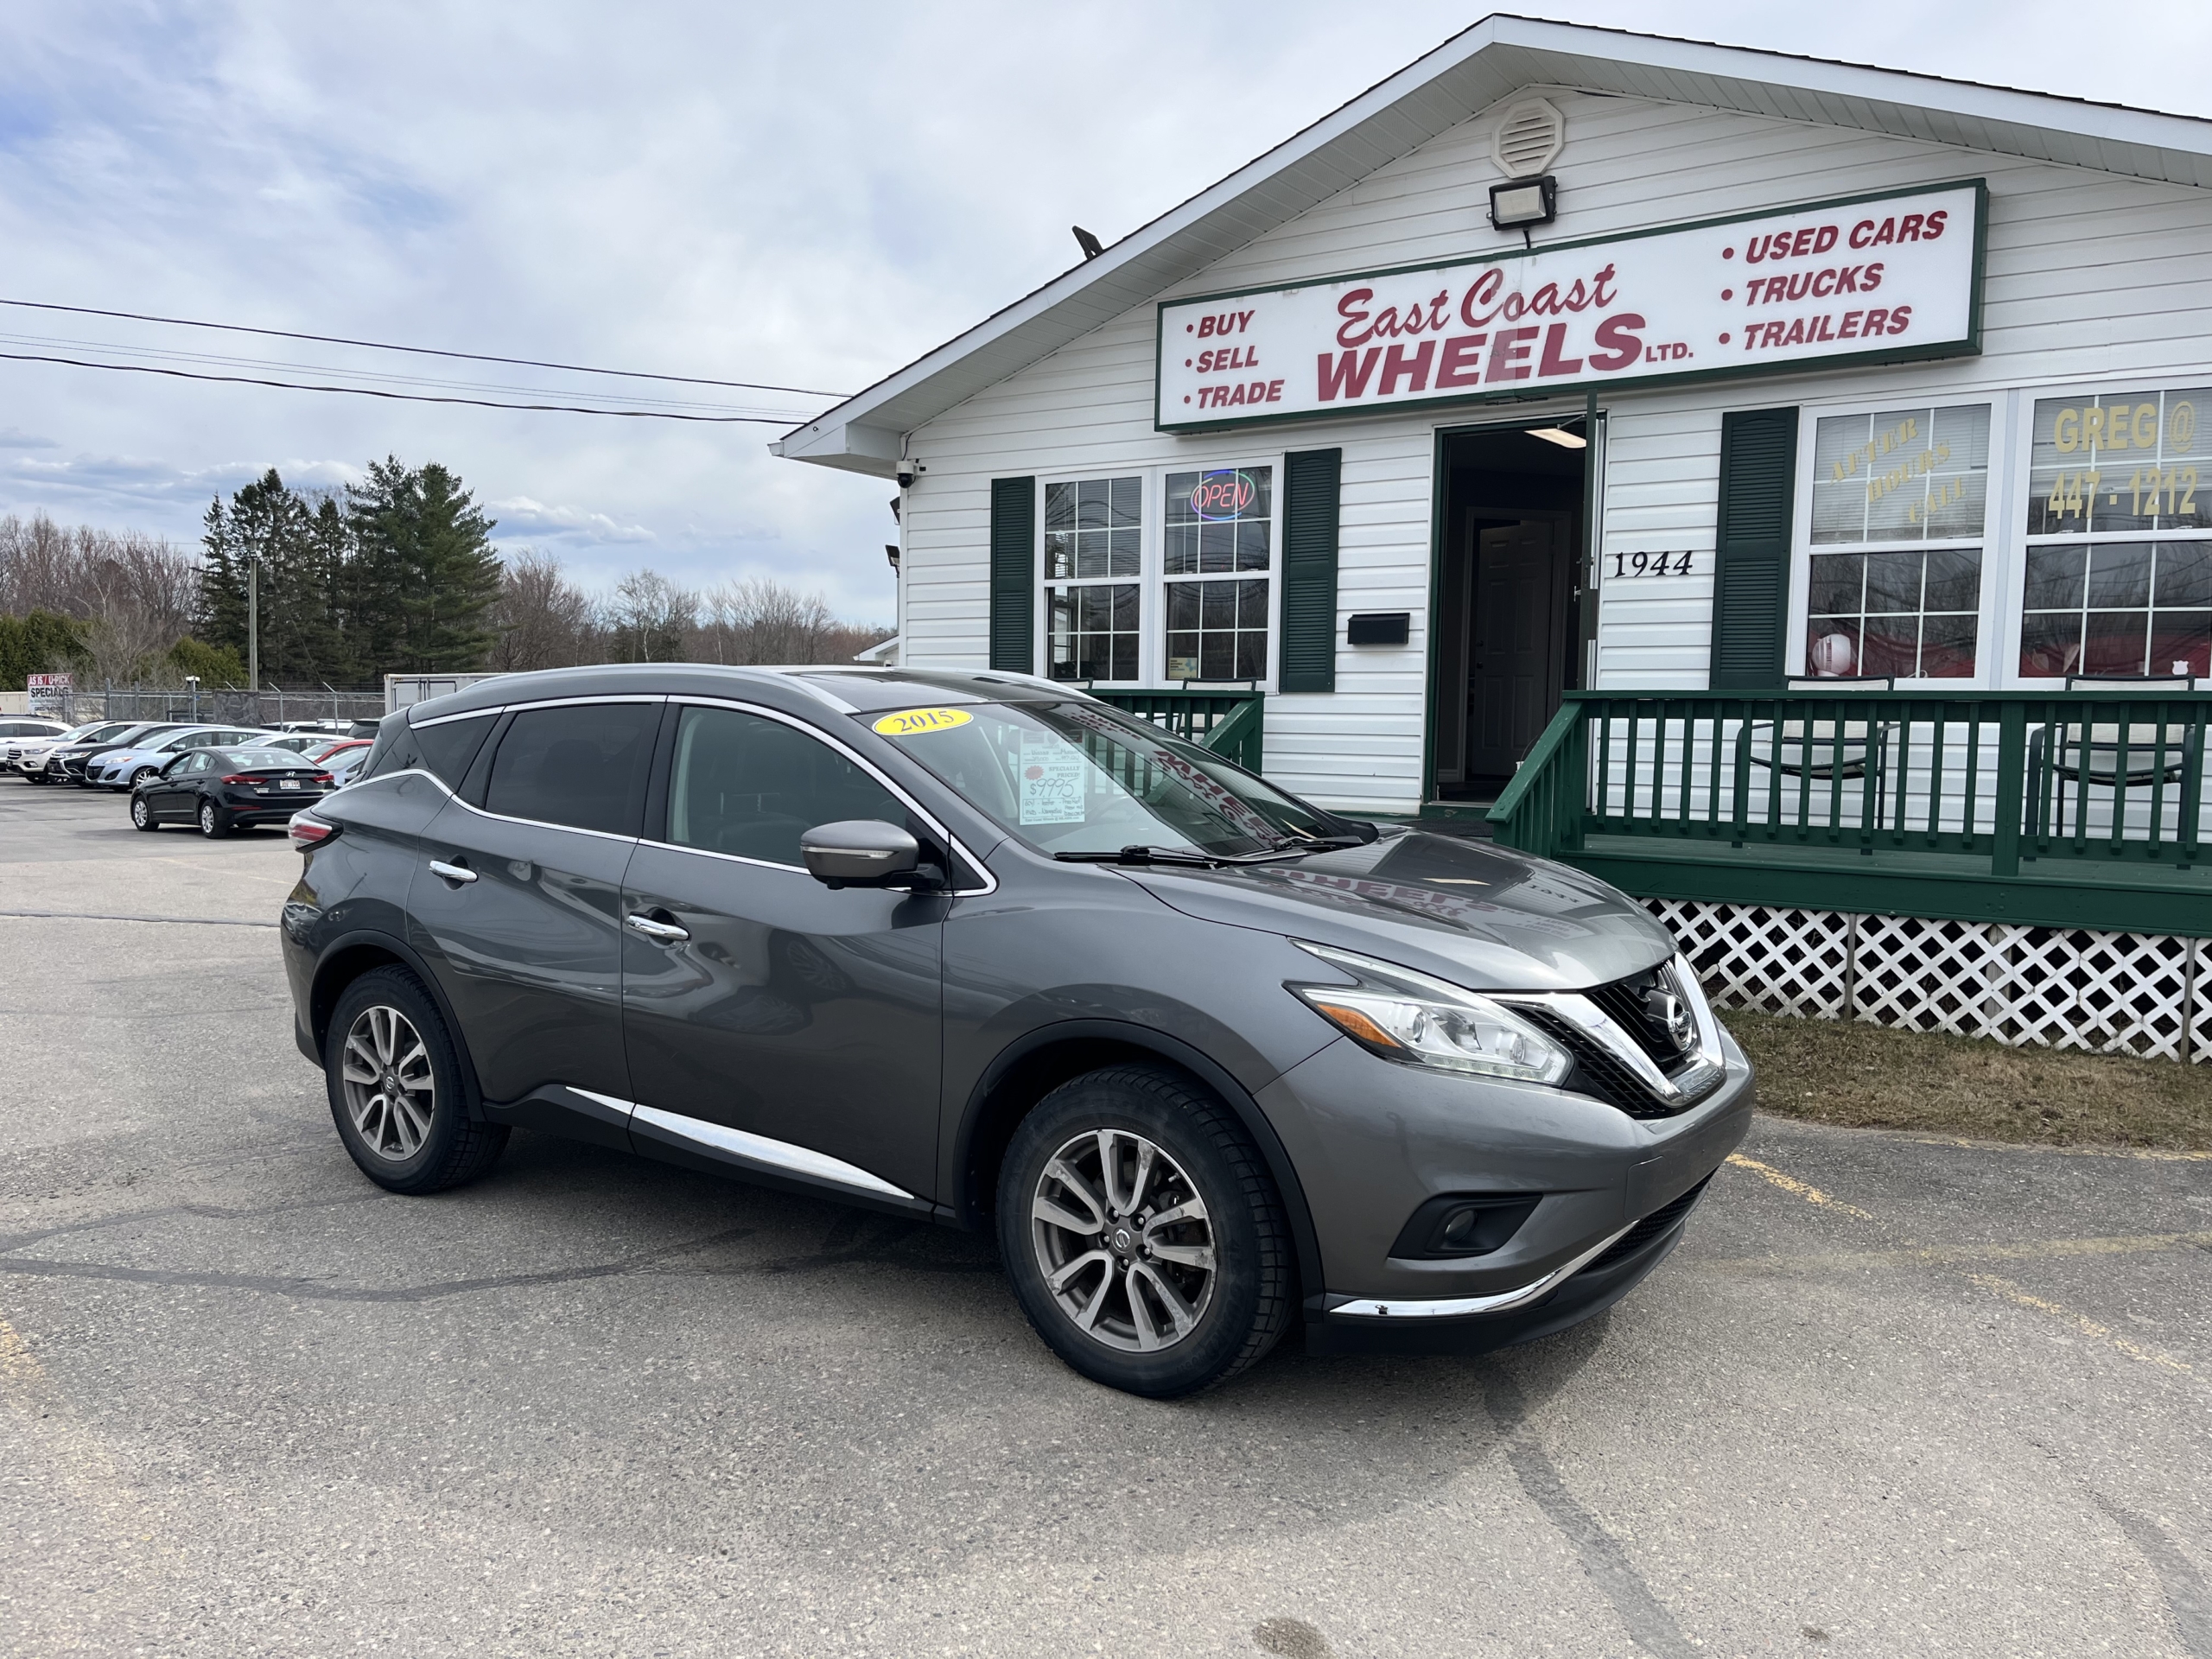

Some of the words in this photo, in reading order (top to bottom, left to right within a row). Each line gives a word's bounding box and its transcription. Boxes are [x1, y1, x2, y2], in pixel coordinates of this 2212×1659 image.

[1745, 226, 1840, 264] USED
[1848, 210, 1948, 249] CARS
[1337, 288, 1450, 348] East
[1460, 263, 1618, 328] Coast
[1745, 263, 1885, 307] TRUCKS
[1198, 309, 1255, 338] BUY
[1744, 306, 1912, 350] TRAILERS
[1197, 345, 1259, 373] SELL
[1318, 313, 1646, 402] WHEELS
[1646, 342, 1694, 362] LTD.
[1198, 379, 1285, 409] TRADE
[2054, 403, 2157, 454] GREG
[1830, 417, 1919, 486] AFTER
[1866, 439, 1950, 504] HOURS
[1194, 482, 1249, 509] OPEN
[1909, 477, 1967, 524] CALL
[1614, 550, 1694, 578] 1944
[893, 710, 955, 733] 2015
